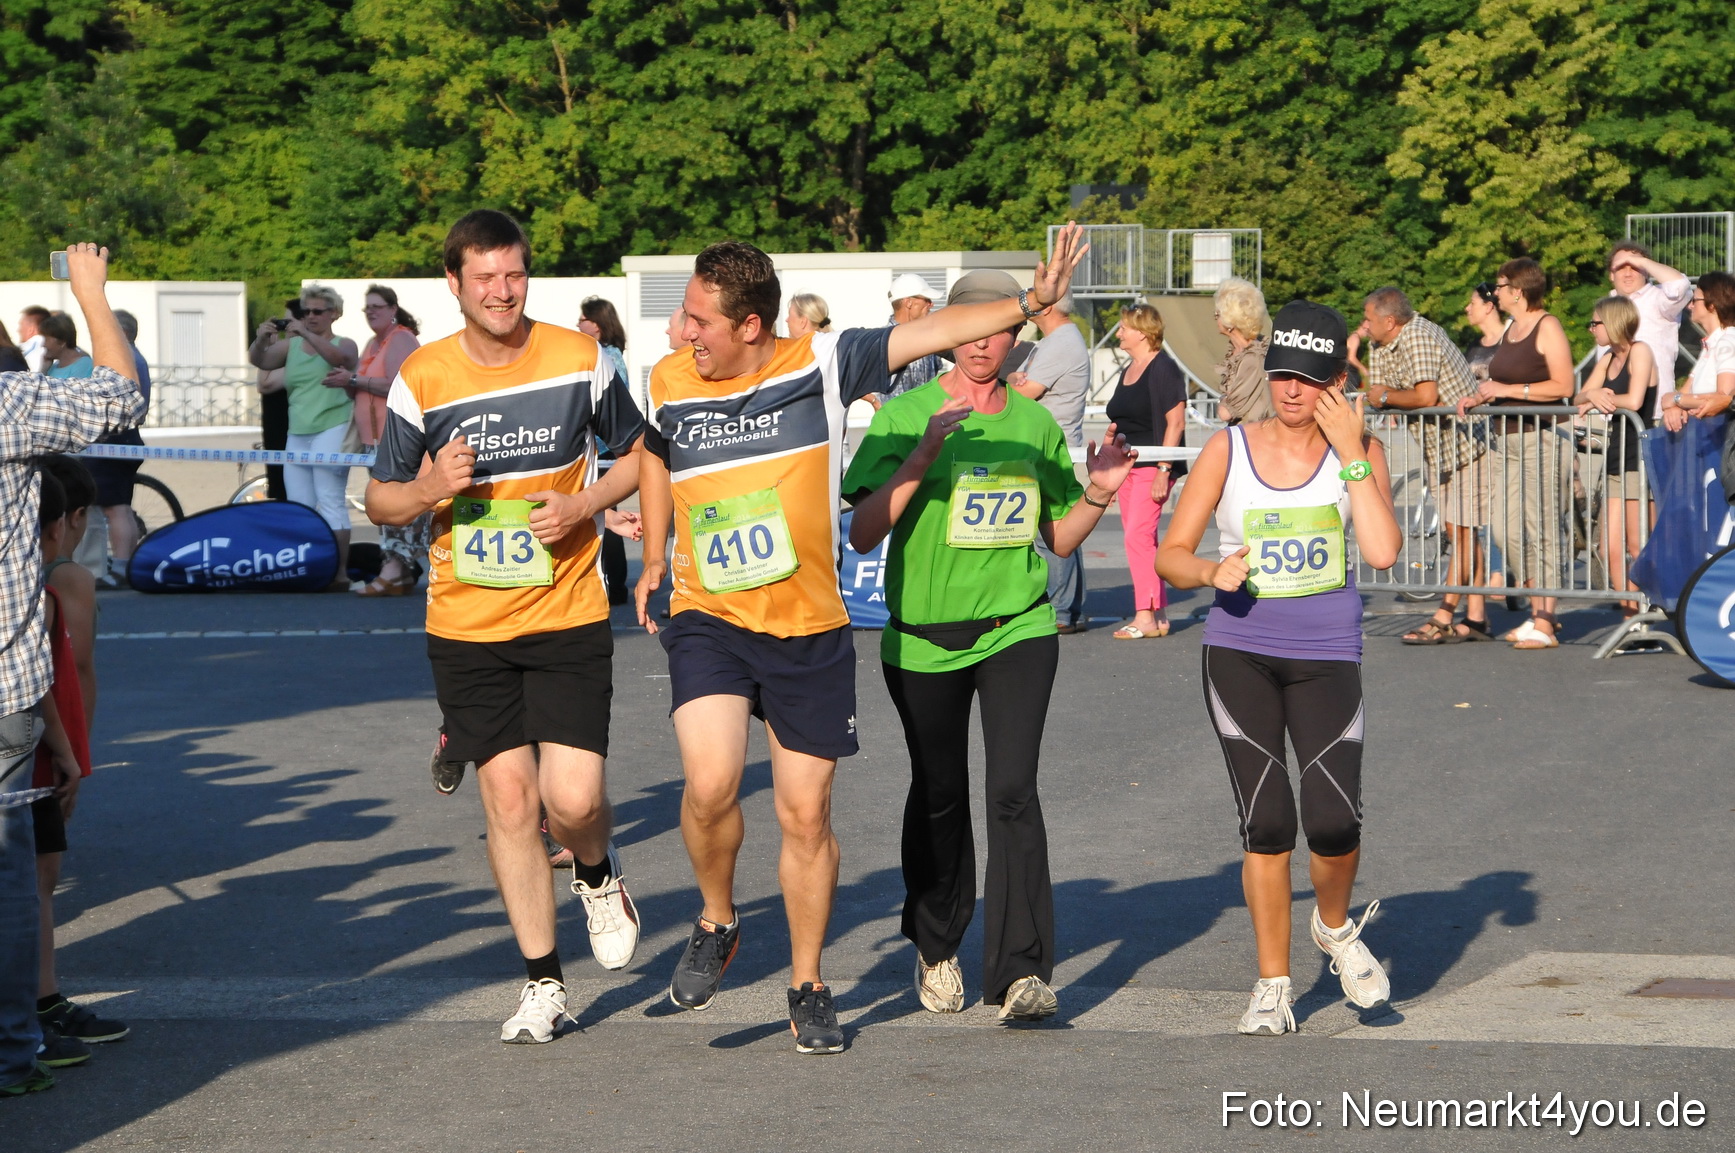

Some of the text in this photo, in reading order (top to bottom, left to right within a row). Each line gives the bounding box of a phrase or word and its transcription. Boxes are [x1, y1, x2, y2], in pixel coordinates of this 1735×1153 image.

[1273, 328, 1335, 354] adidas
[467, 425, 561, 451] Fischer
[688, 410, 783, 442] Fischer
[697, 427, 779, 451] AUTOMOBILE
[476, 443, 556, 462] AUTOMOBILE
[962, 491, 1027, 526] 572
[464, 528, 535, 565] 413
[706, 524, 774, 569] 410
[1260, 536, 1329, 575] 596
[184, 541, 313, 584] Fischer
[481, 565, 502, 573] Andreas
[724, 562, 768, 577] Christian Vestner
[718, 567, 779, 586] Fischer Automobile GmbH
[1315, 577, 1337, 585] Neumarkt
